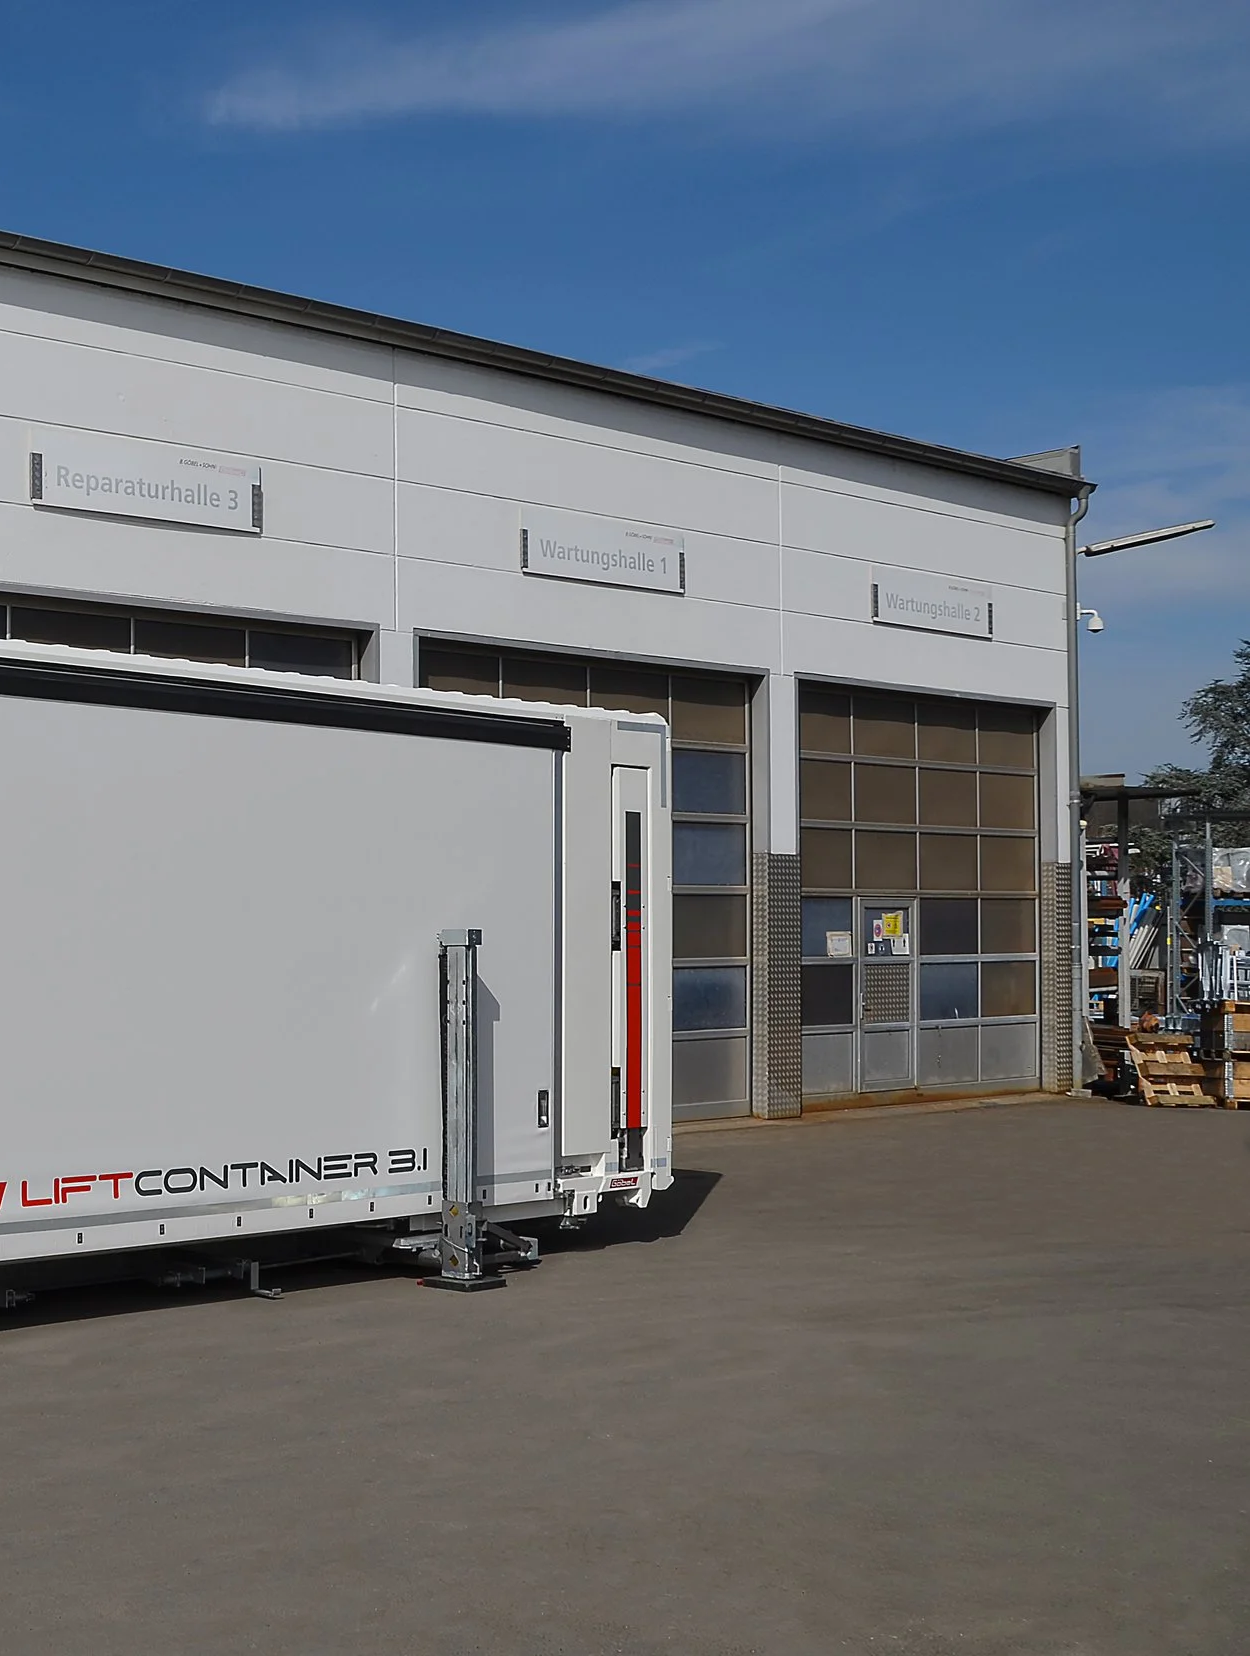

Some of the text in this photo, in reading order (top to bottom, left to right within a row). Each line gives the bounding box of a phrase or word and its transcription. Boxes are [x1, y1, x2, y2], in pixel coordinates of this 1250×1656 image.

[56, 465, 239, 511] Reparaturhalle 3
[540, 538, 667, 574] Wartungshalle 1
[885, 592, 981, 622] Wartungshalle 2
